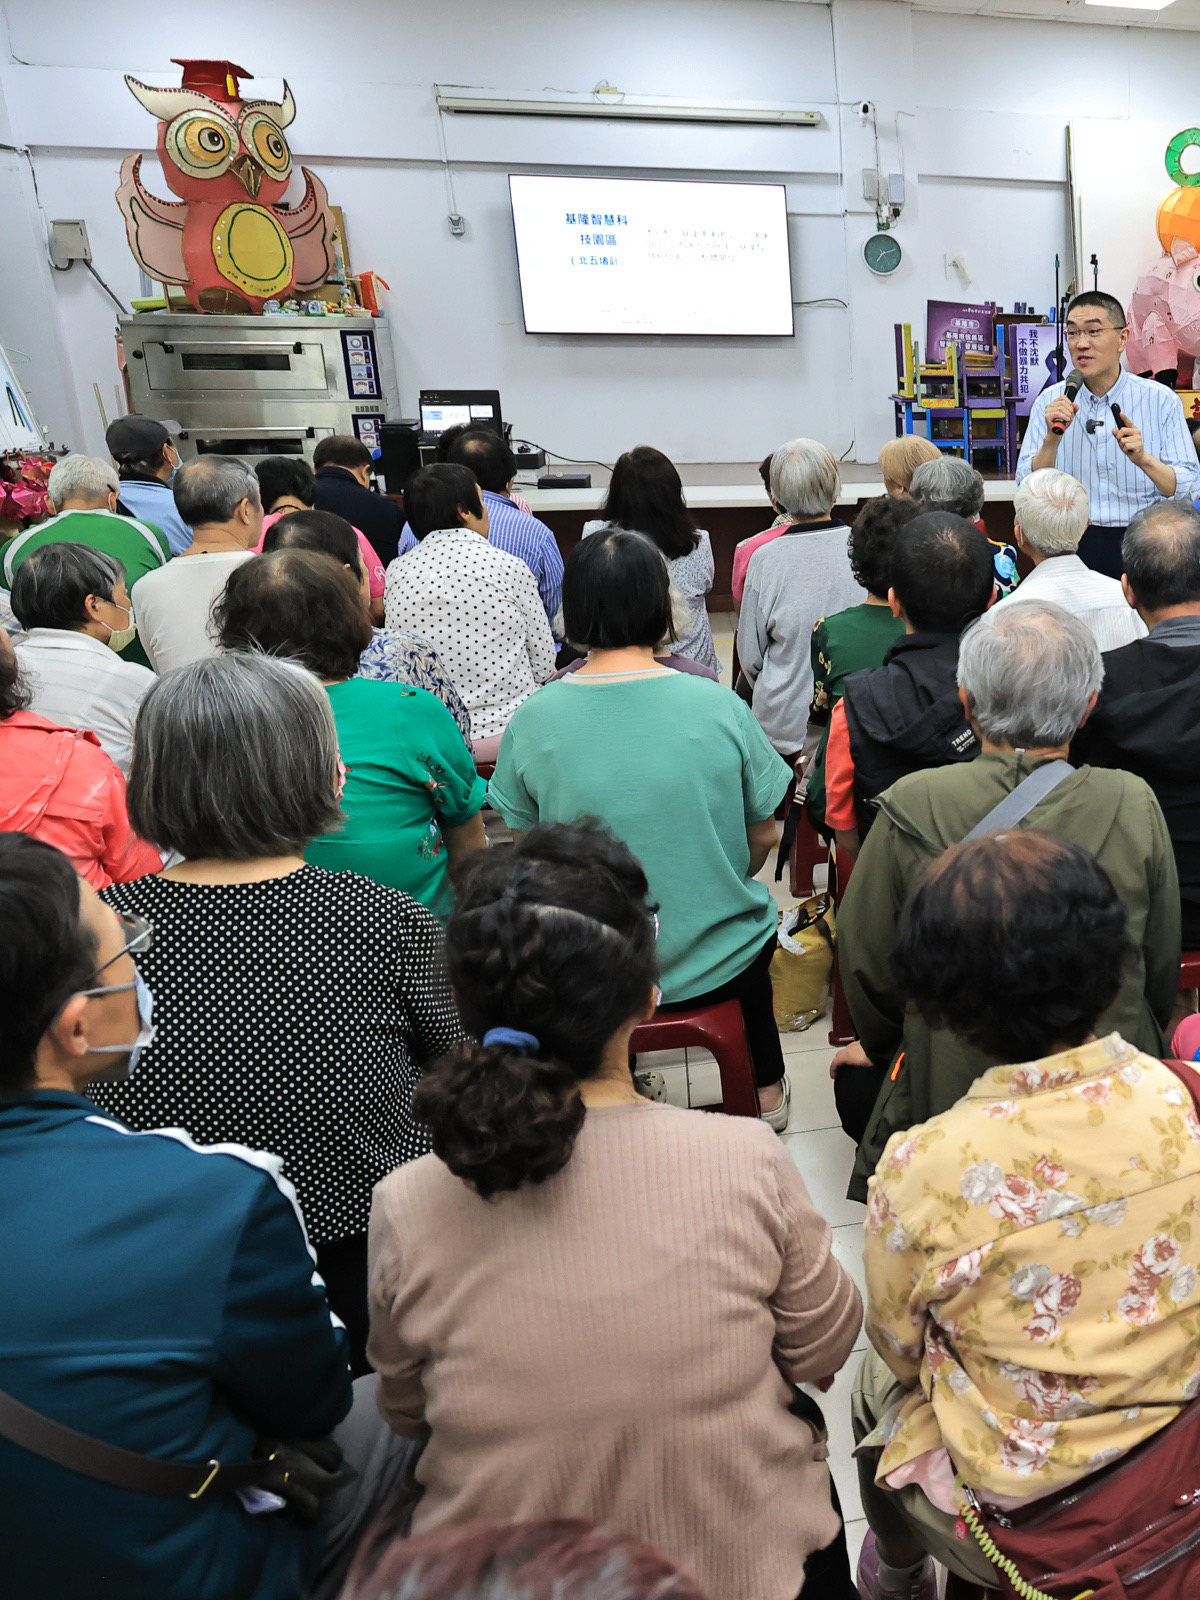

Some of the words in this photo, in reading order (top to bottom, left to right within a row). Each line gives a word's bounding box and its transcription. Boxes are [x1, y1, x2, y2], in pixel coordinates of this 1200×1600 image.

[566, 213, 627, 226] 基隆智慧科
[580, 234, 617, 246] 技園區
[1018, 338, 1029, 394] 不做暴力共犯
[951, 728, 972, 747] TREND
